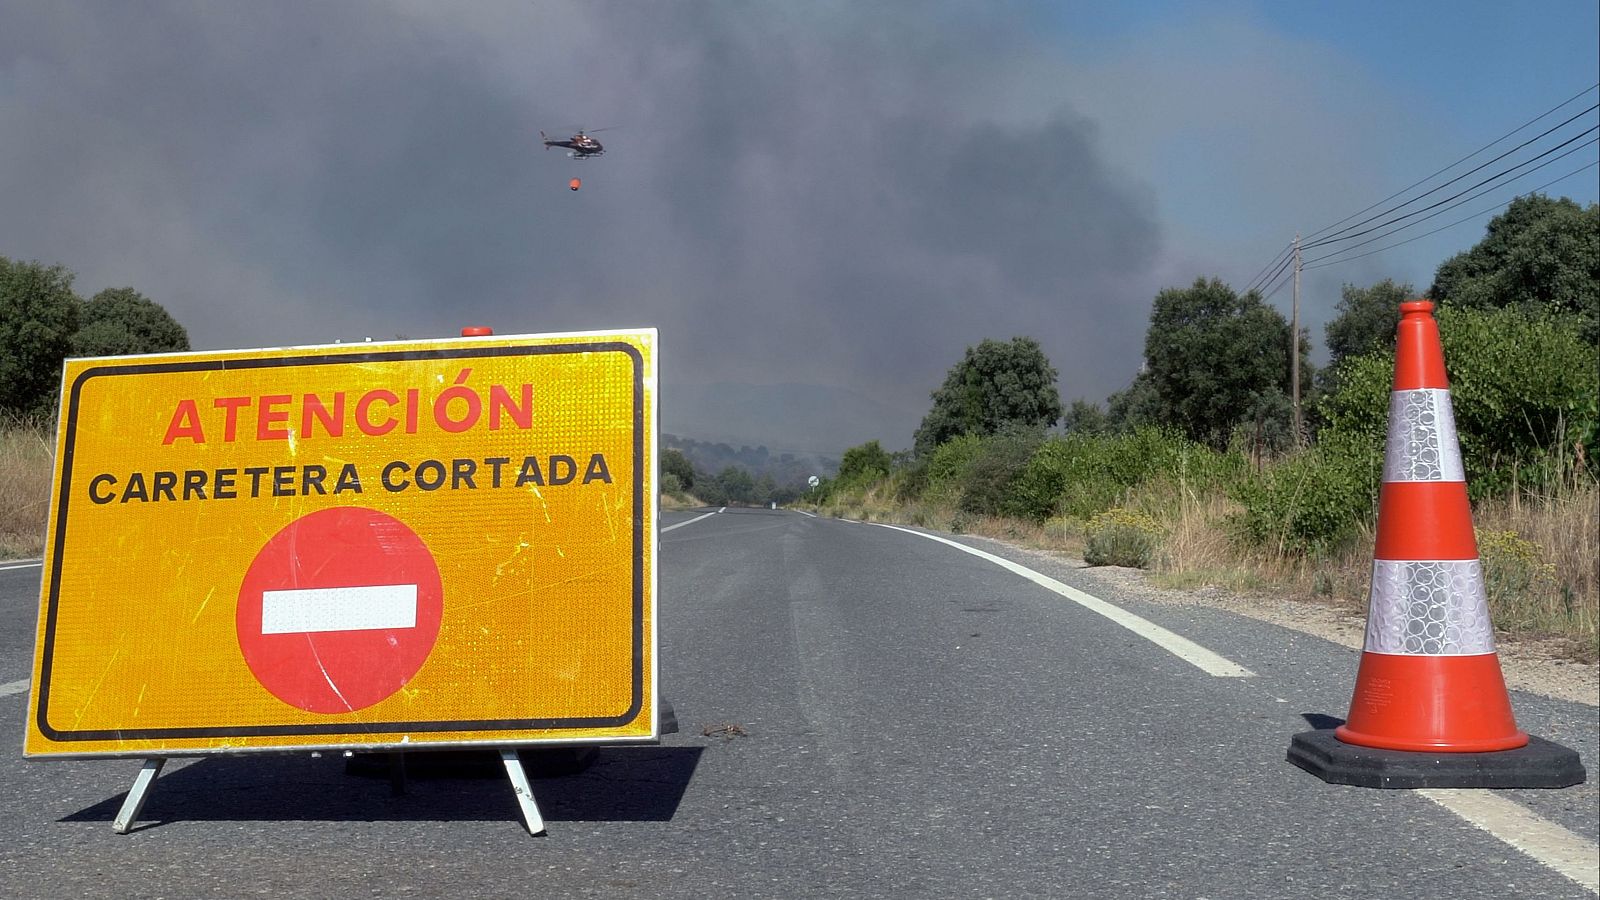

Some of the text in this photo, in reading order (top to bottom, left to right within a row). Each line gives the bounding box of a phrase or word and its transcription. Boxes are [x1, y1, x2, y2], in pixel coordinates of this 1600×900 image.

[163, 368, 534, 445] ATENCIÓN
[88, 453, 613, 505] CARRETERA CORTADA
